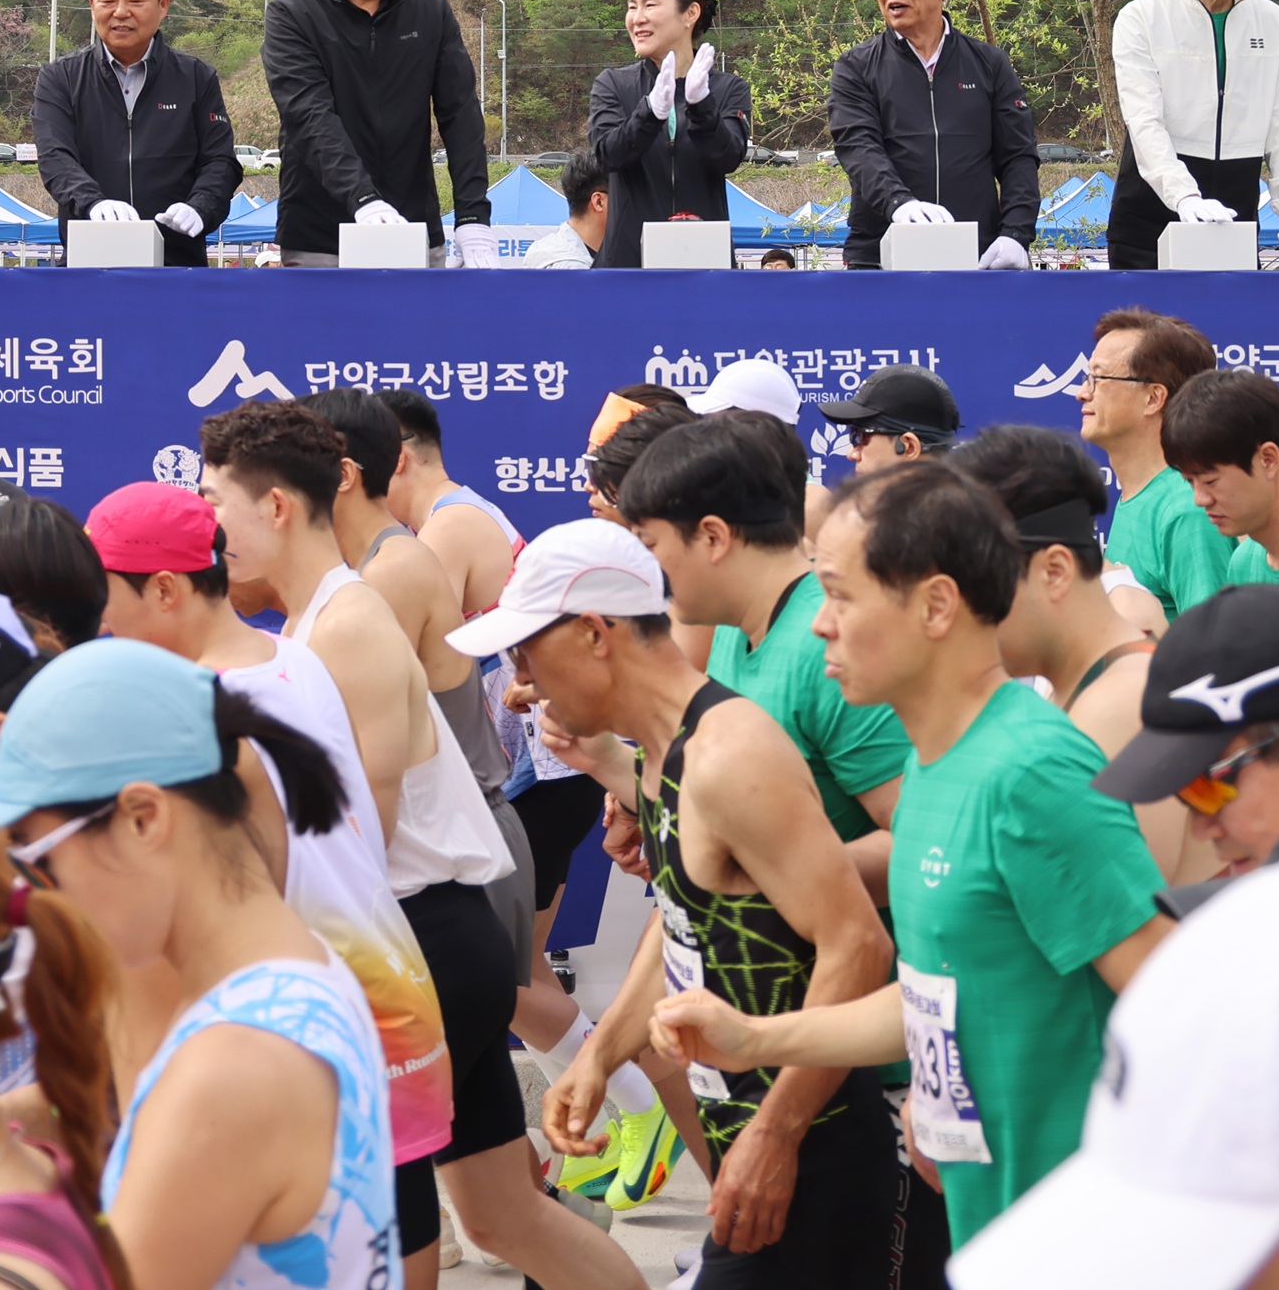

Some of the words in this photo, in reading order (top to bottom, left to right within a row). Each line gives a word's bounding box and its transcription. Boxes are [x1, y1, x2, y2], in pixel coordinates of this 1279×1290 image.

[39, 385, 103, 404] Council
[304, 360, 569, 400] 단양군산림조합
[947, 1039, 975, 1111] 10km
